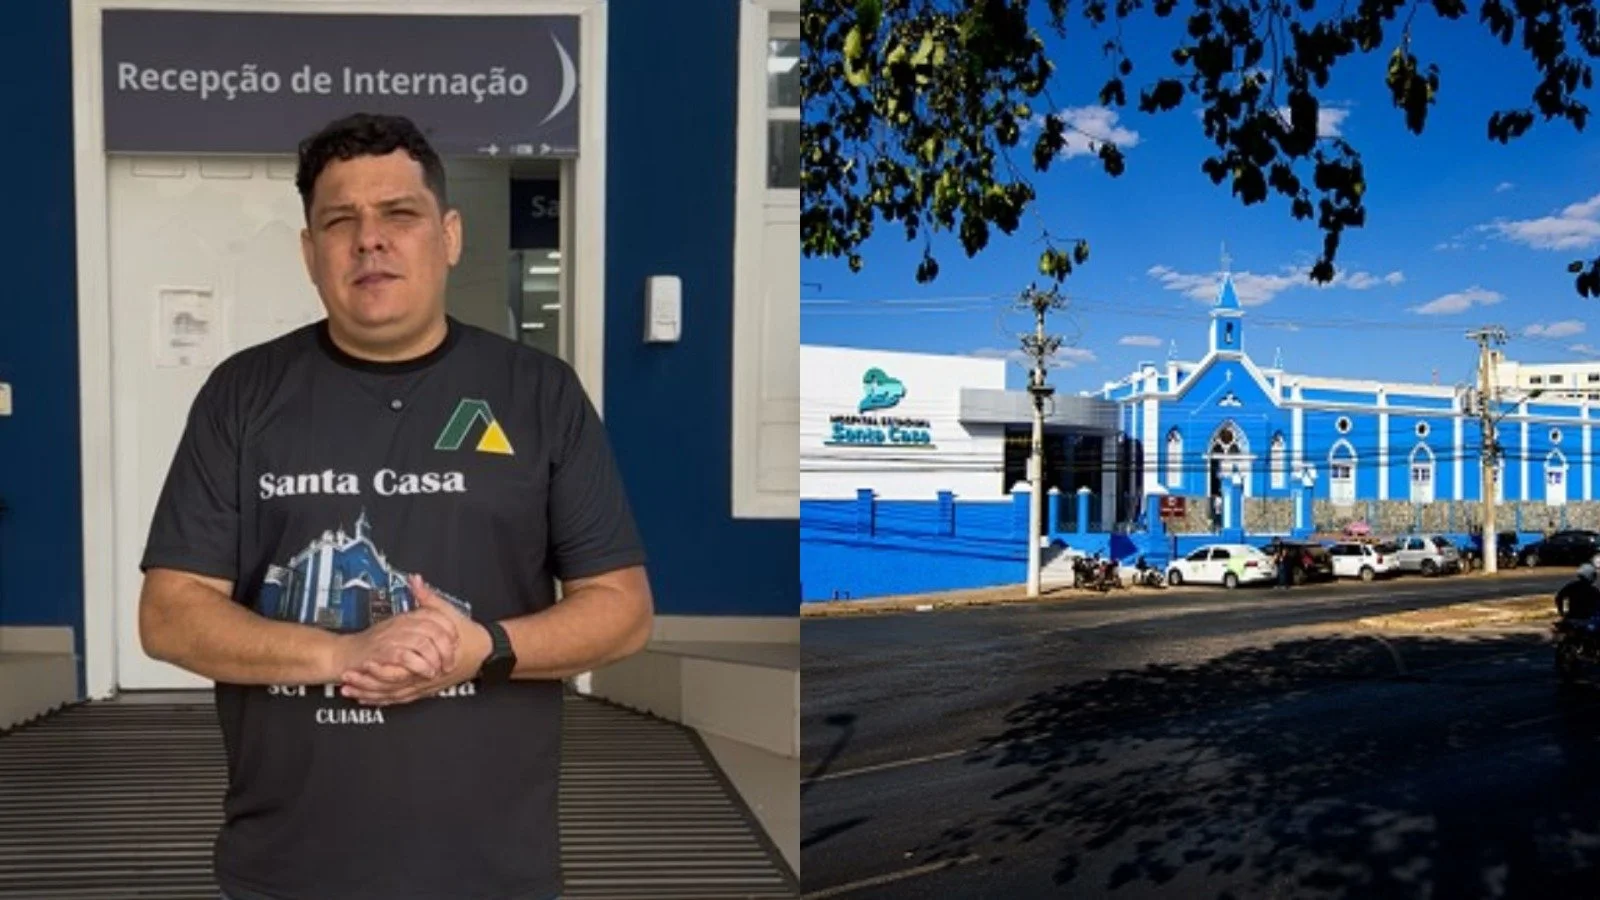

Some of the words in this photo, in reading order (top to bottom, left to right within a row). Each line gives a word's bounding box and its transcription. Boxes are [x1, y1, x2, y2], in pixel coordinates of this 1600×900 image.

[117, 62, 280, 100] Recepção
[290, 65, 332, 94] de
[343, 67, 528, 103] Internação
[832, 421, 885, 442] Santa
[888, 424, 931, 444] Casa
[258, 469, 360, 499] Santa
[373, 468, 467, 496] Casa
